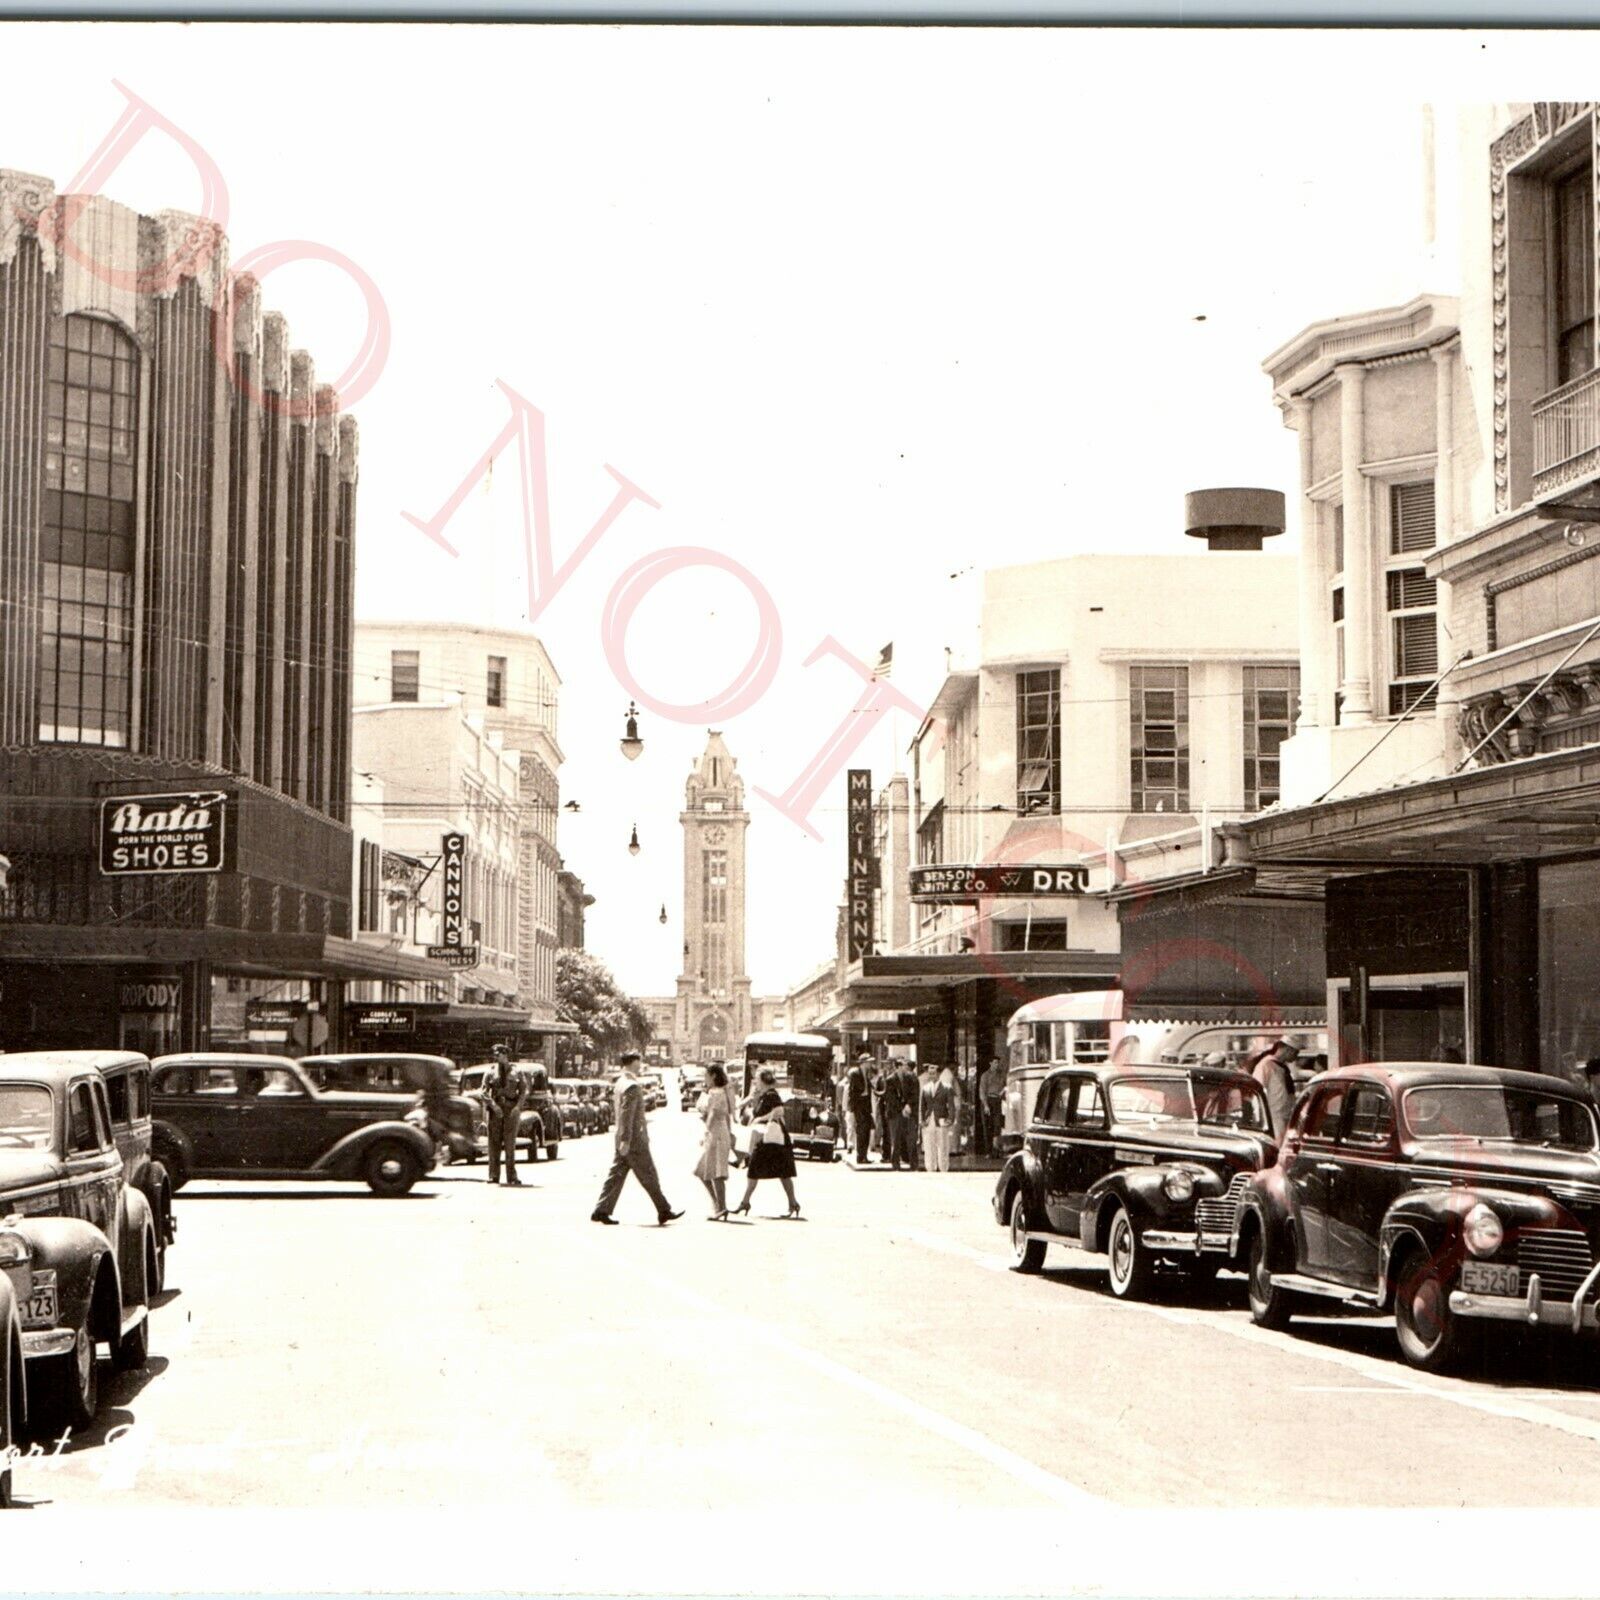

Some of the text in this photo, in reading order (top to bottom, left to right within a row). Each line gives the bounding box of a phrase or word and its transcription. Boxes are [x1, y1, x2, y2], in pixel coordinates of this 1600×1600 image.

[118, 833, 204, 845] WORN THE WORLD OVER
[112, 844, 209, 868] SHOES
[923, 870, 976, 882] BENSON
[952, 880, 961, 891] &
